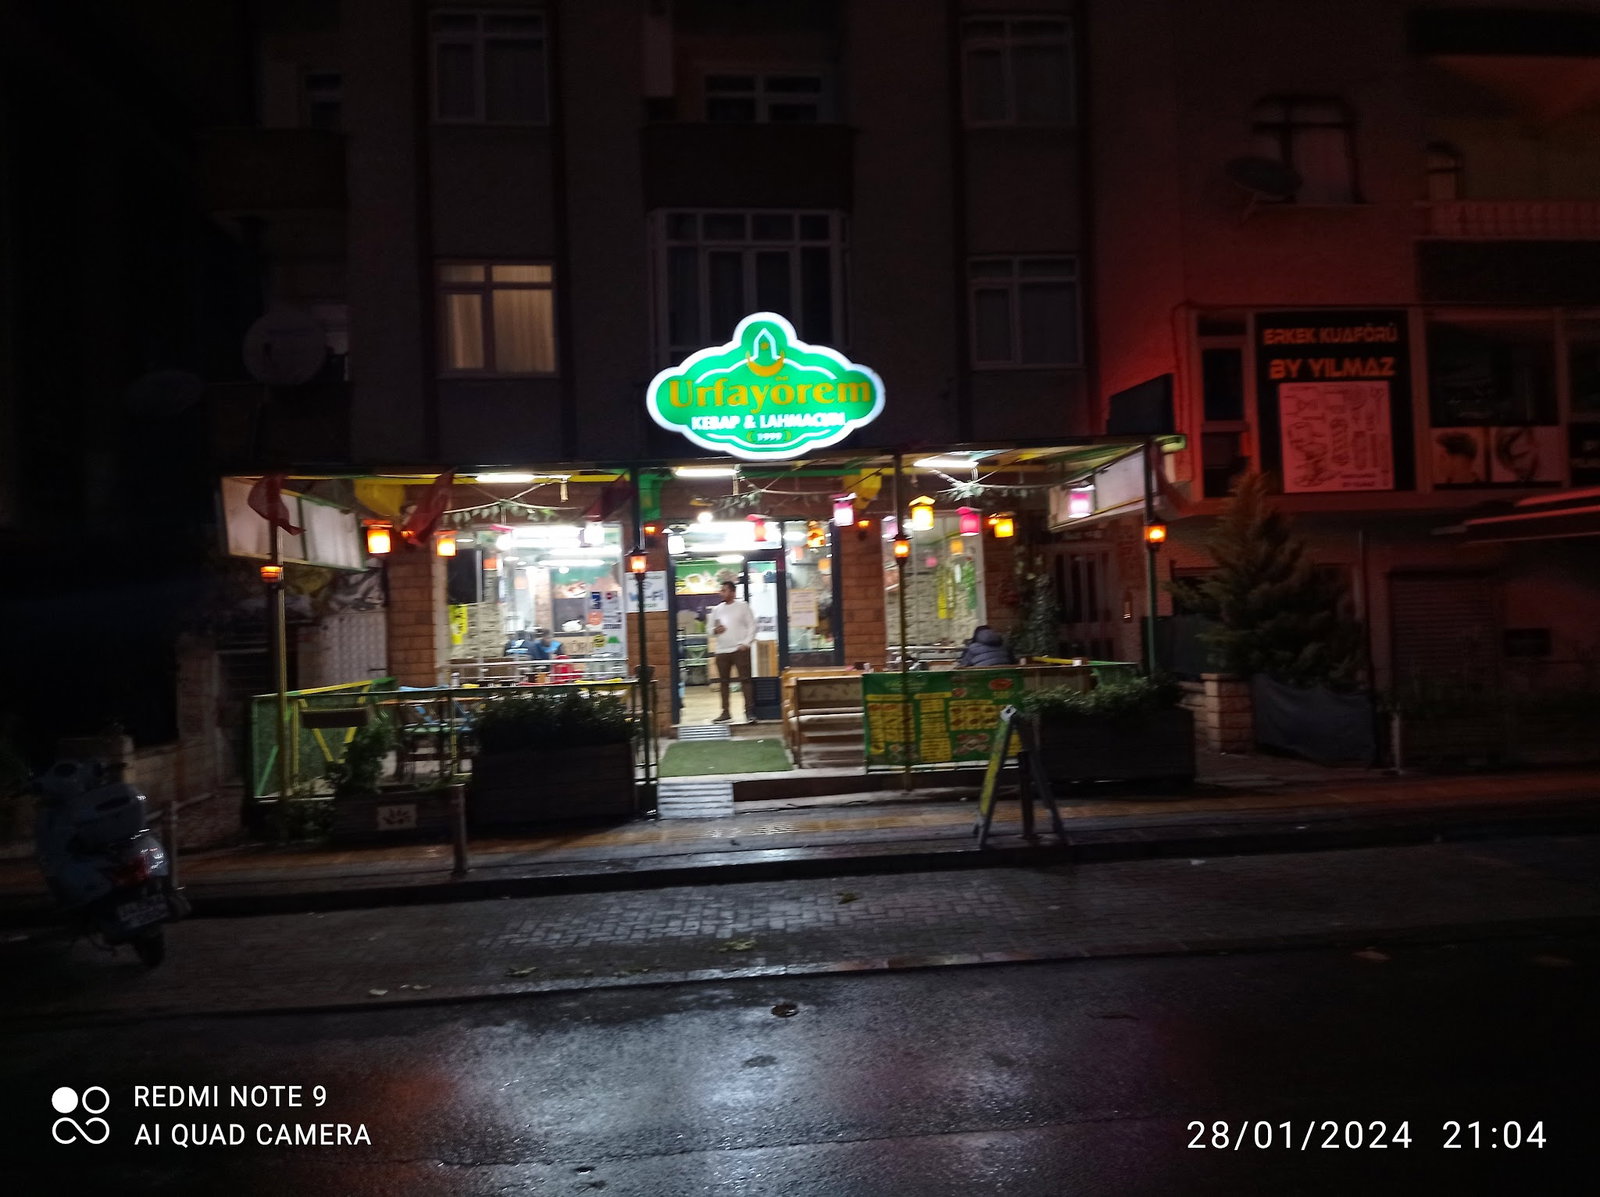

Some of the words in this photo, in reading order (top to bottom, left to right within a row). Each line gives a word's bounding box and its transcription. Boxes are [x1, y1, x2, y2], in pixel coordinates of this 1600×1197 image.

[1263, 328, 1317, 345] ERKEK
[1319, 322, 1397, 344] KUAFÖRÜ
[1270, 358, 1302, 379] BY
[1308, 356, 1396, 378] YILMAZ
[669, 375, 872, 414] Urfayörem
[691, 415, 741, 430] KEBAP
[743, 415, 757, 429] &
[759, 411, 846, 428] LAHMACUN
